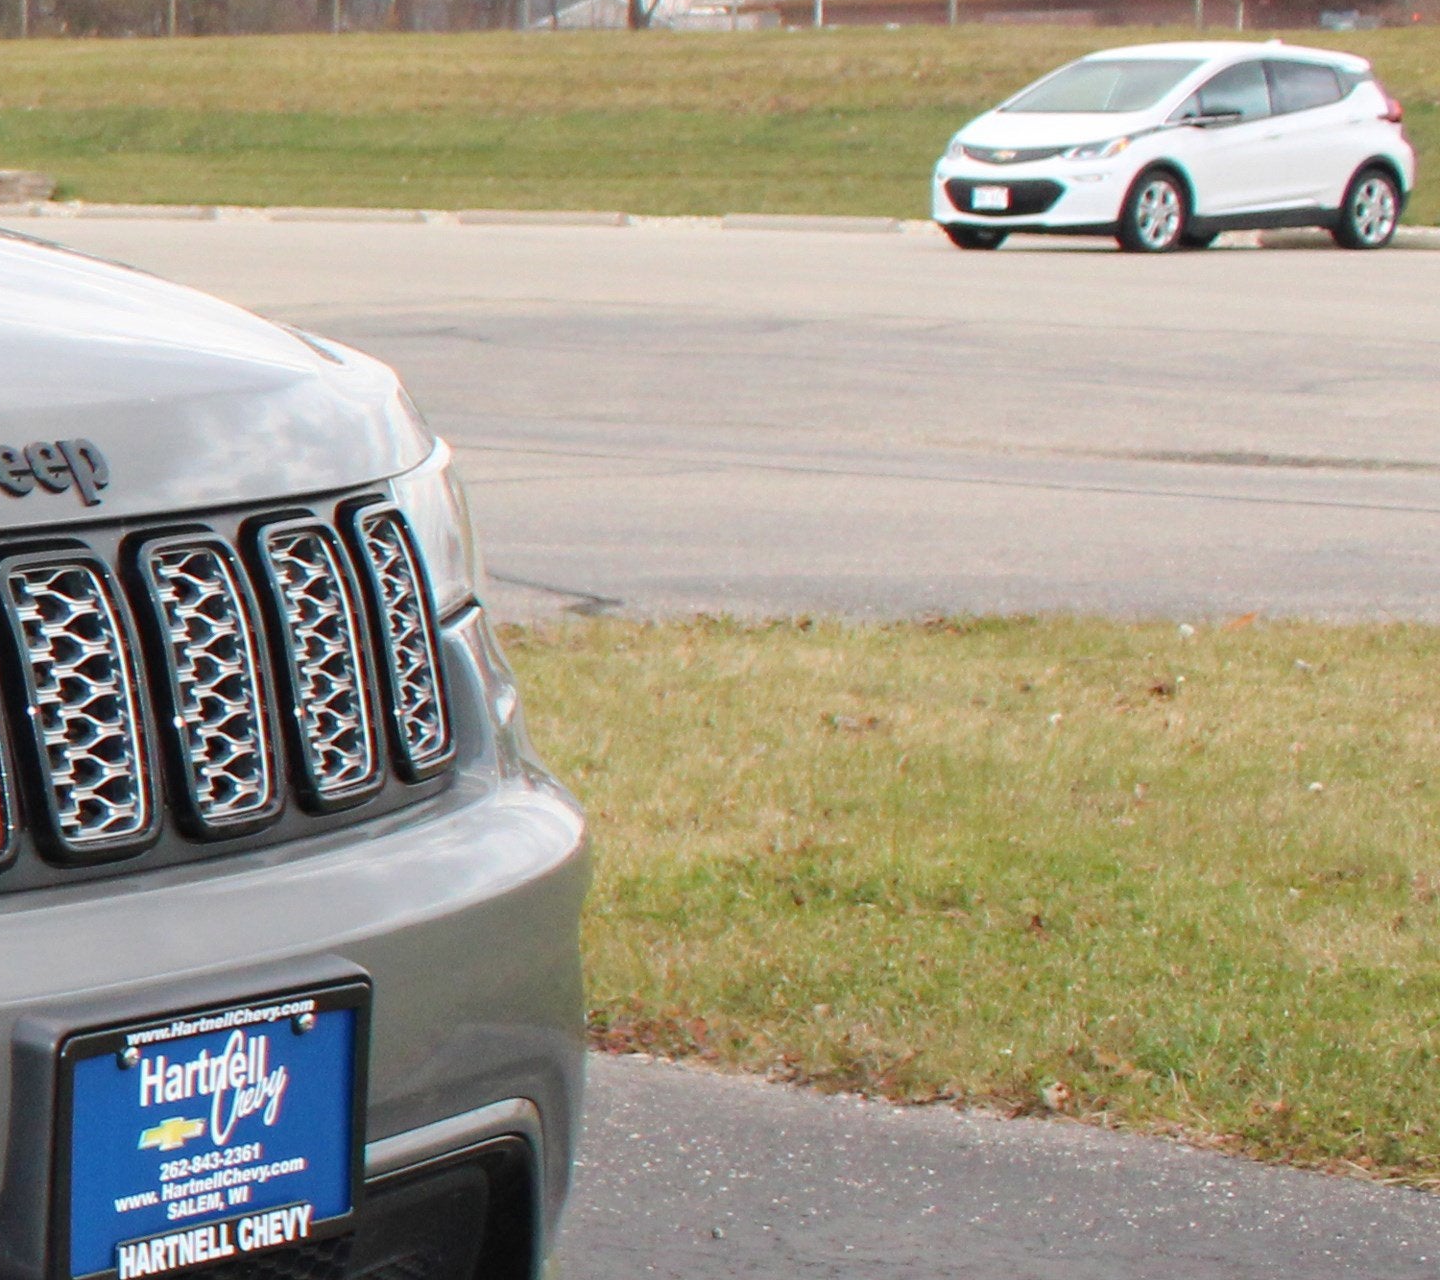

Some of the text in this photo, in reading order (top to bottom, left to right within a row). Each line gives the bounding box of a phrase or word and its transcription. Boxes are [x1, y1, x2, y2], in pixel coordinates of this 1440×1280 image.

[126, 999, 316, 1047] www.HartnellChevy.com
[140, 1034, 268, 1106] Hartnell
[209, 1029, 288, 1147] Chevy
[160, 1144, 261, 1181] 262-843-2361
[162, 1157, 304, 1201] HartnellChevy.com
[166, 1186, 249, 1221] SALEM, WI
[118, 1205, 312, 1280] HARTNELL CHEVY
